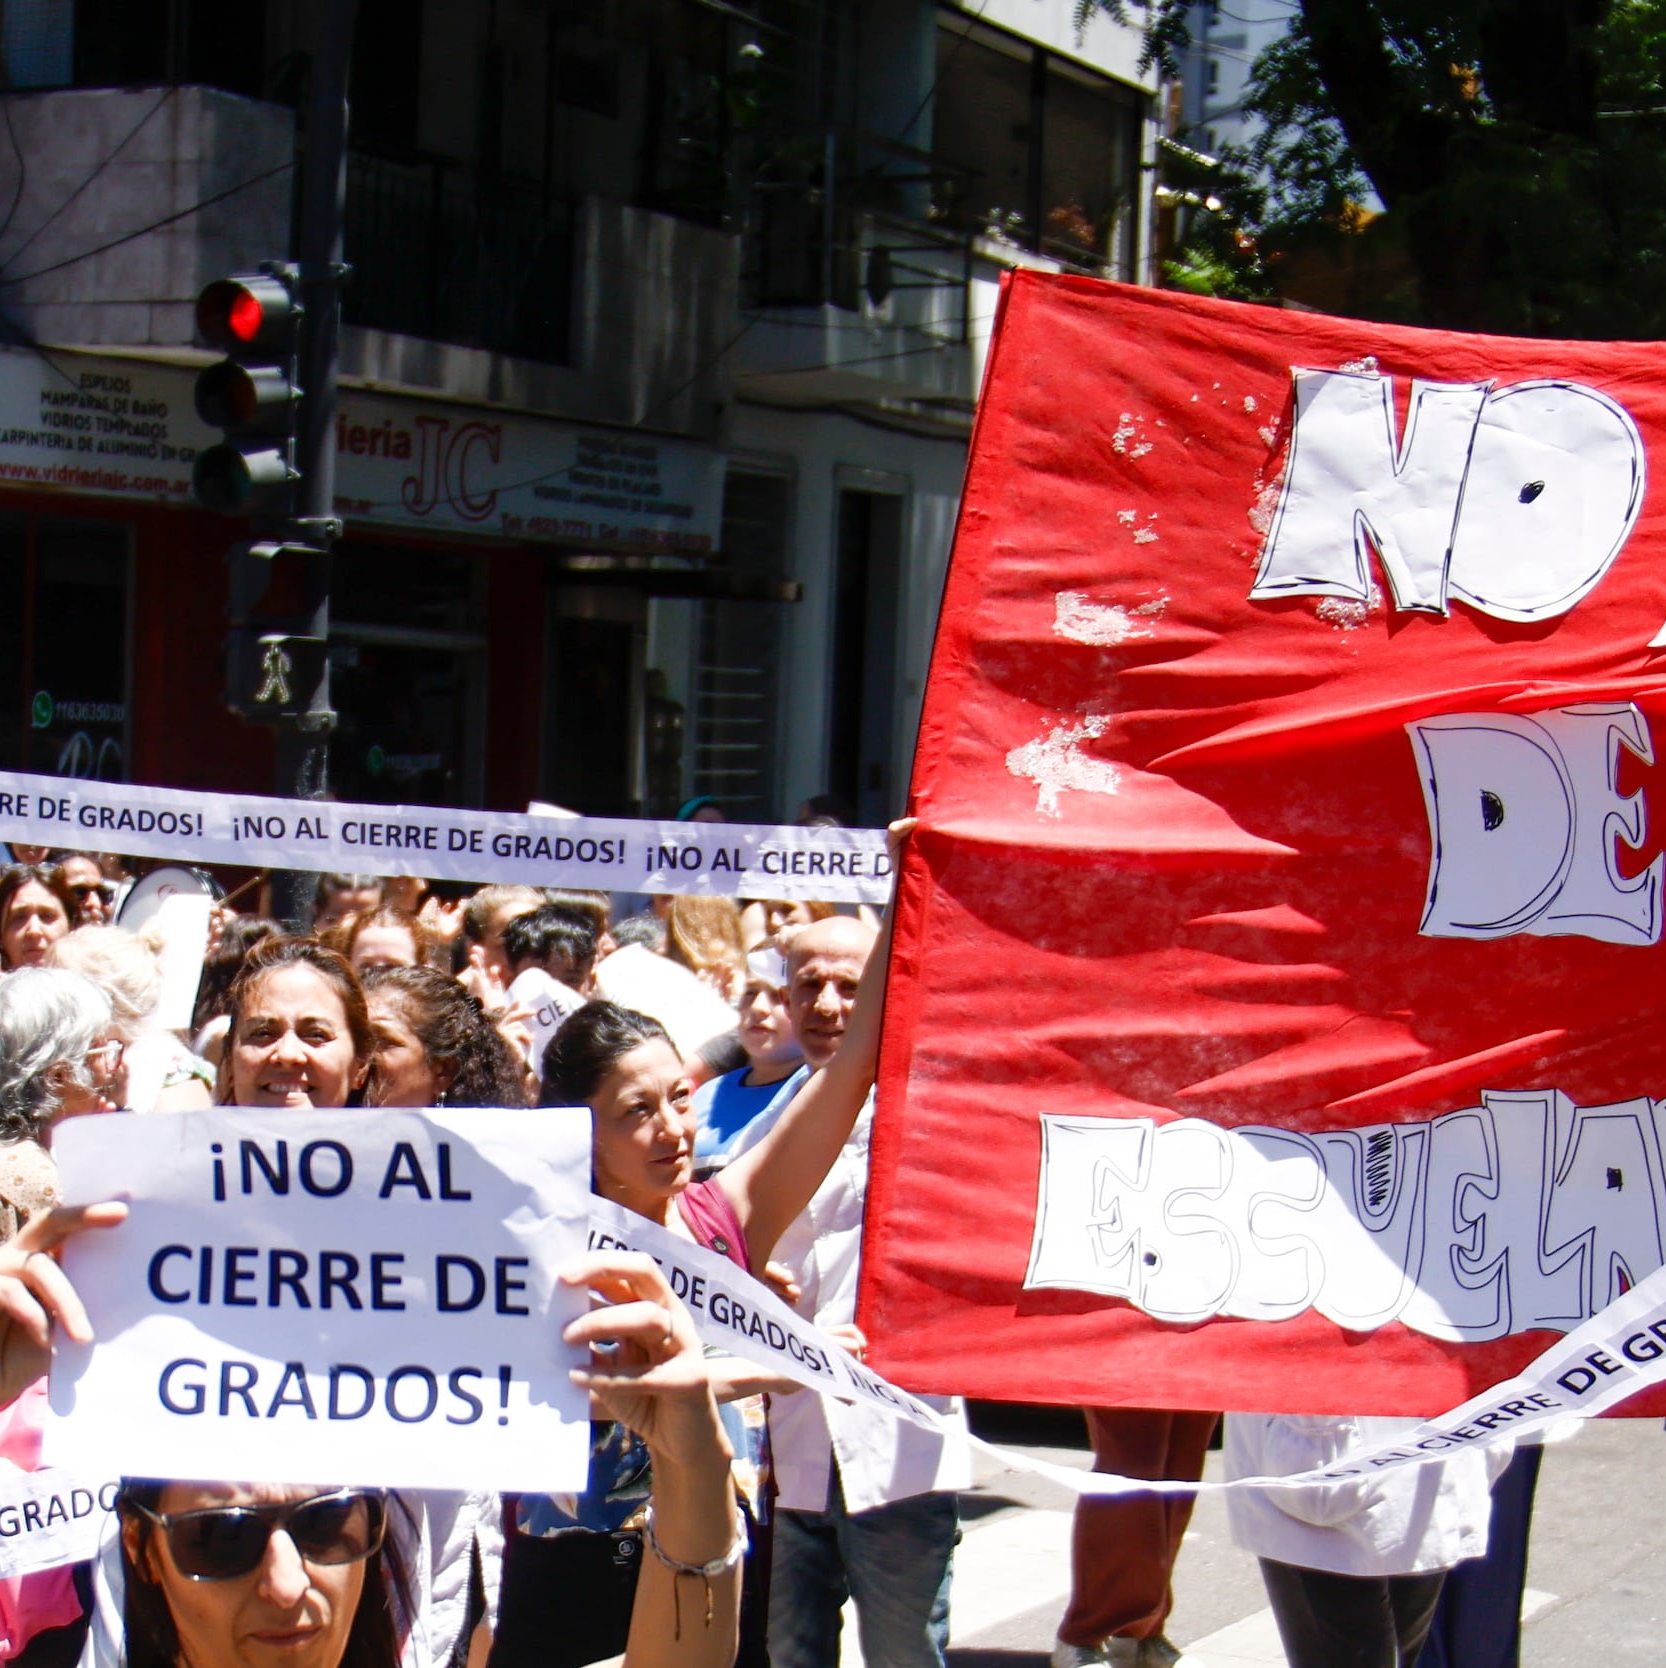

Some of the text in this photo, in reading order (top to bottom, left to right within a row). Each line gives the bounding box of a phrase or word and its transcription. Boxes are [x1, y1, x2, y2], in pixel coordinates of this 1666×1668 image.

[40, 391, 168, 418] MAMPARAS DE BAÑO
[79, 372, 132, 393] ESPEJOS
[40, 410, 168, 439] VIDRIOS TEMPLADOS
[77, 435, 93, 452] DE
[97, 440, 158, 459] ALUMINIO
[336, 413, 412, 459] ieria
[401, 415, 502, 522] JC
[1248, 362, 1646, 623] NO
[38, 797, 72, 822] DE
[78, 804, 204, 837] GRADOS!
[233, 816, 286, 841] ¡NO
[294, 817, 329, 840] AL
[341, 821, 438, 850] CIERRE
[447, 828, 484, 854] DE
[492, 832, 626, 864] GRADOS!
[646, 845, 702, 872] ¡NO
[710, 848, 748, 872] AL
[762, 851, 864, 876] CIERRE
[874, 853, 892, 876] D
[1405, 702, 1666, 946] DE
[536, 999, 566, 1027] CIE
[209, 1140, 471, 1201] ¡NO AL
[146, 1244, 531, 1316] CIERRE DE
[670, 1265, 707, 1309] DE
[708, 1292, 834, 1376] GRADOS!
[157, 1358, 512, 1426] GRADOS!
[1416, 1392, 1563, 1451] CIERRE
[1556, 1349, 1623, 1395] DE
